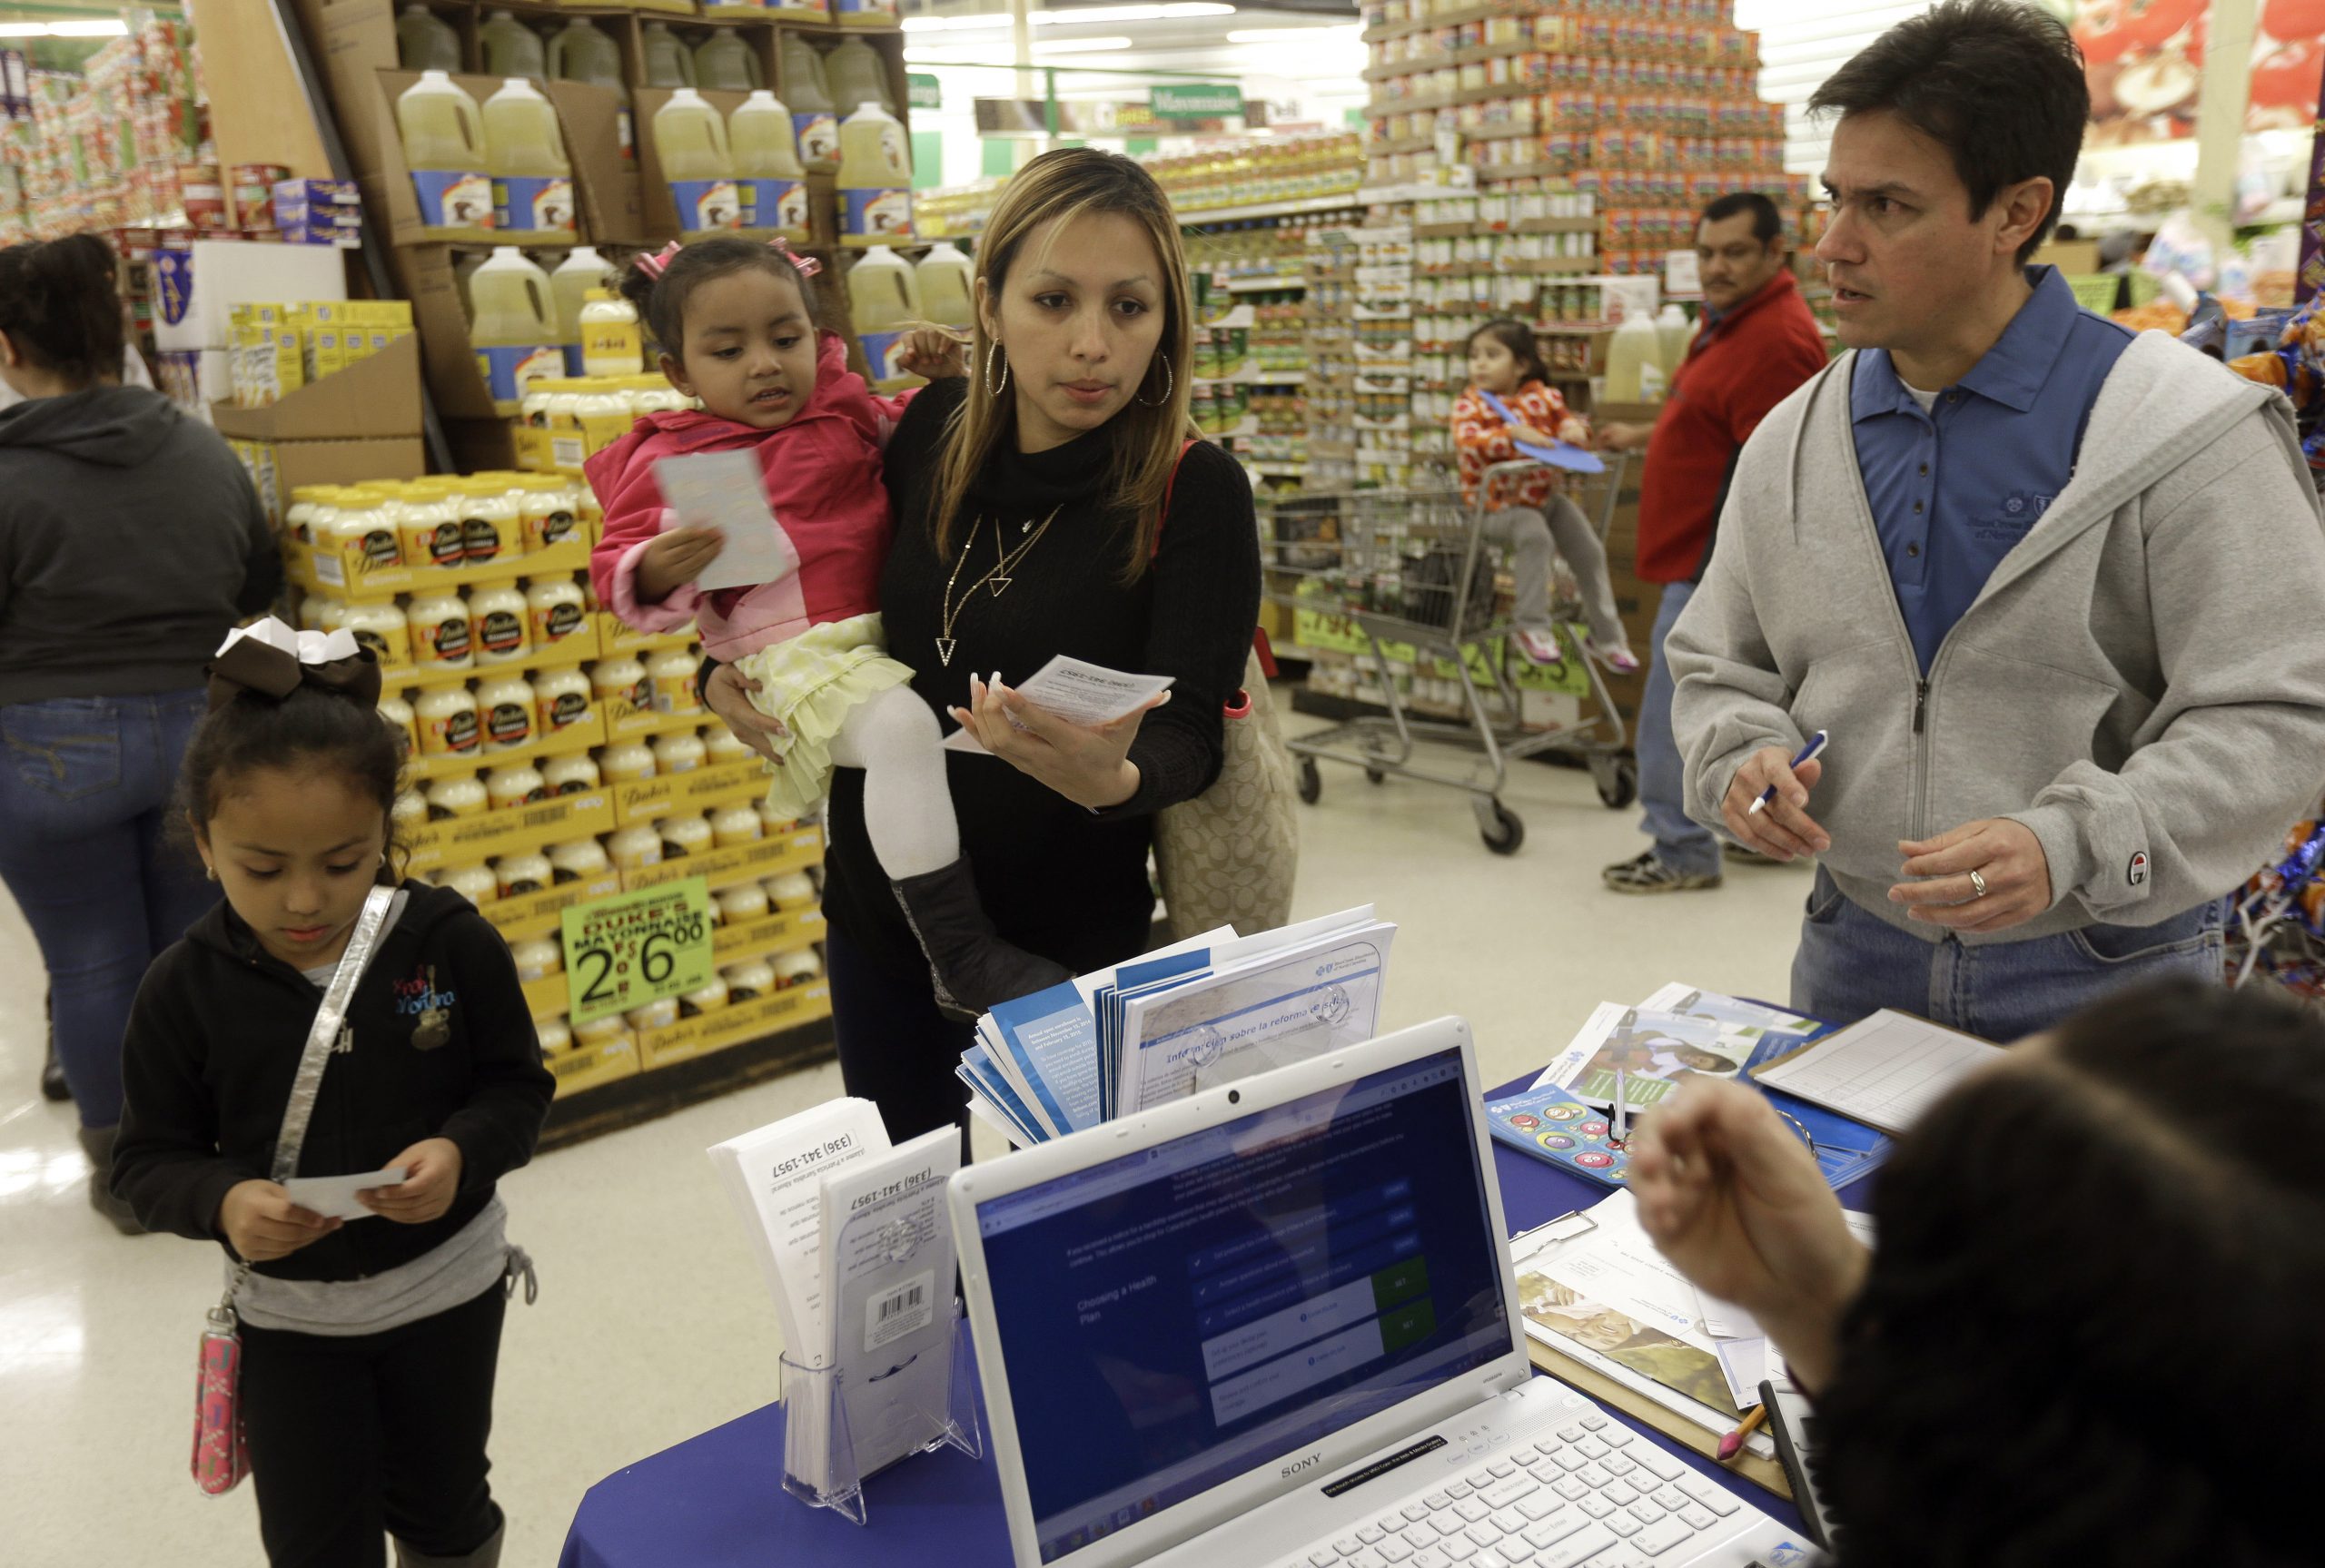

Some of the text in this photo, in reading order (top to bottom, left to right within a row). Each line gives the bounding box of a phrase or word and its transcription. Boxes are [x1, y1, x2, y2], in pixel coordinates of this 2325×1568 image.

[575, 912, 702, 951] MAYONNAISE
[577, 949, 614, 1003] 2
[1031, 1033, 1050, 1044] between
[1050, 1026, 1073, 1037] November
[1230, 1026, 1256, 1041] sobre
[1260, 1021, 1267, 1031] la
[1271, 1009, 1307, 1027] reforma
[1043, 1036, 1063, 1047] February
[773, 1133, 852, 1178] (336) 341-1957
[816, 1160, 841, 1173] Patricia
[851, 1167, 931, 1211] (336) 341-1957
[1077, 1276, 1157, 1311] Choosing a Health
[1080, 1311, 1101, 1325] Plan
[1281, 1453, 1321, 1478] SONY
[1500, 1477, 1529, 1494] Backspace
[1549, 1519, 1567, 1530] Enter
